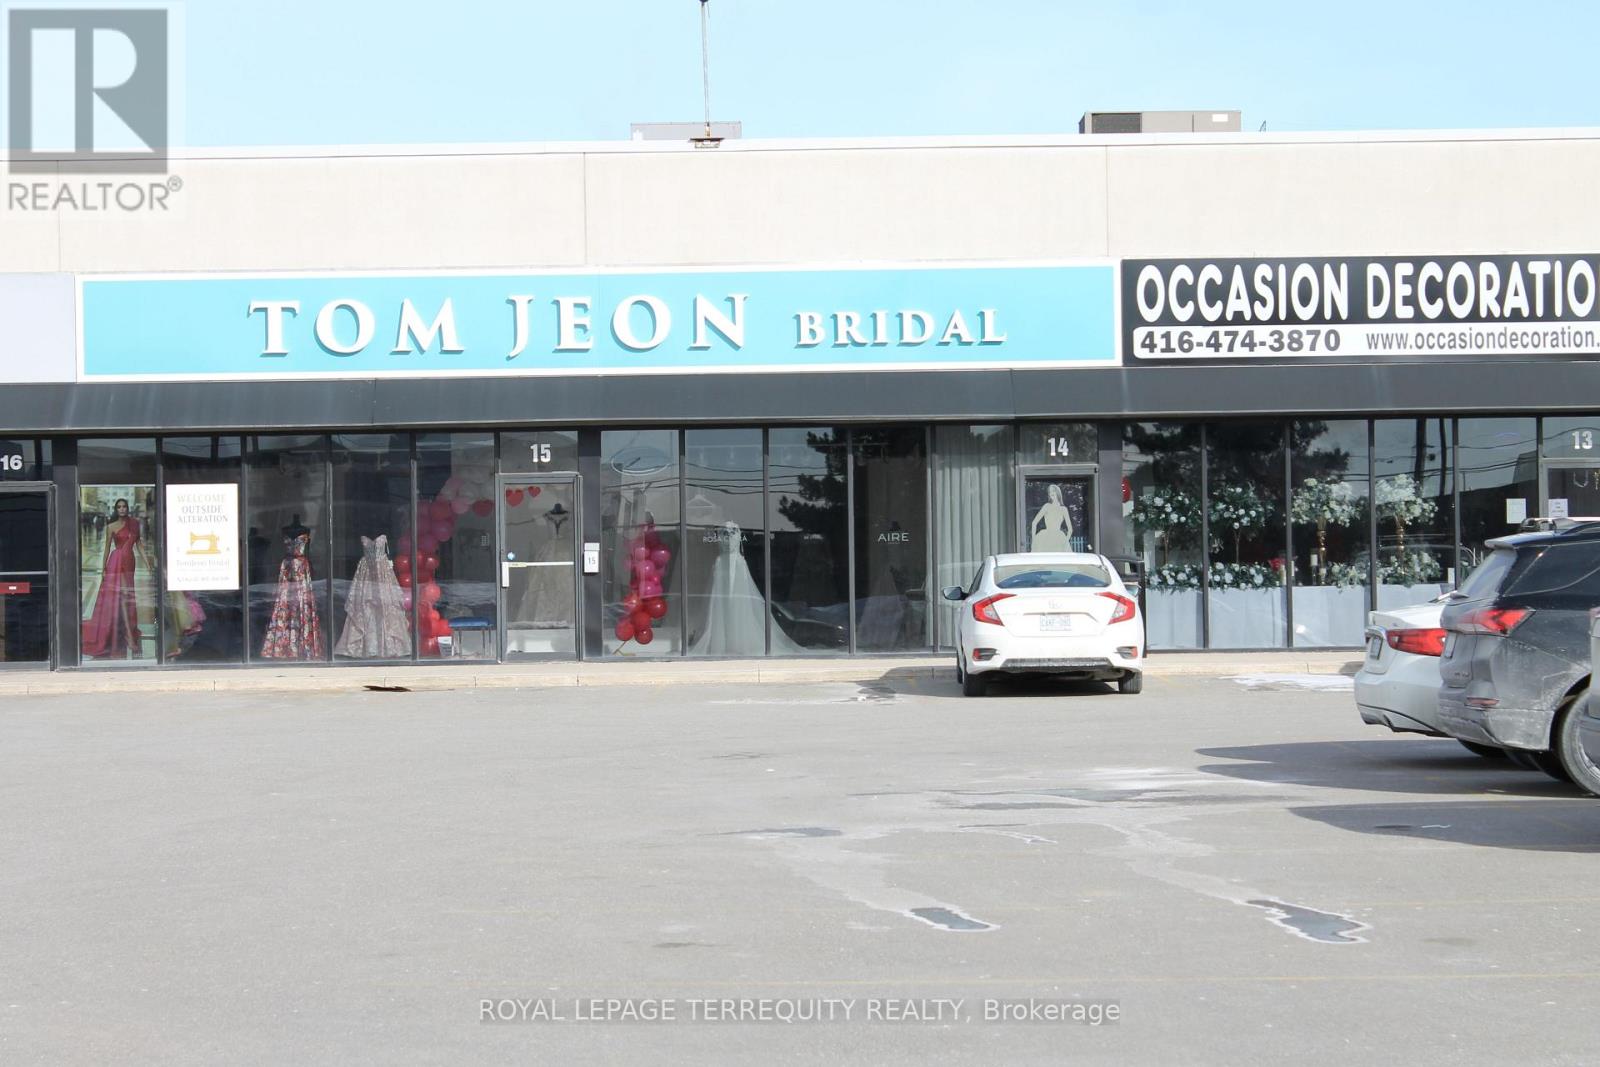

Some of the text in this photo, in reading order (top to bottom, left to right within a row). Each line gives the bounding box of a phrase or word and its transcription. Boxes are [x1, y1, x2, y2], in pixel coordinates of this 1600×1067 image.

[1136, 259, 1600, 322] OCCASION DECORATIO
[247, 293, 1008, 360] TOM JEON BRIDAL
[1140, 328, 1341, 354] 416-474-3870
[1048, 437, 1068, 456] 14
[1572, 430, 1592, 449] 13
[530, 443, 551, 463] 15
[0, 454, 22, 470] 16
[177, 494, 226, 503] WELCOME
[181, 505, 224, 514] OUTSIDE
[177, 514, 228, 523] ALTERATION
[877, 532, 909, 542] AIRE
[588, 556, 596, 565] 15
